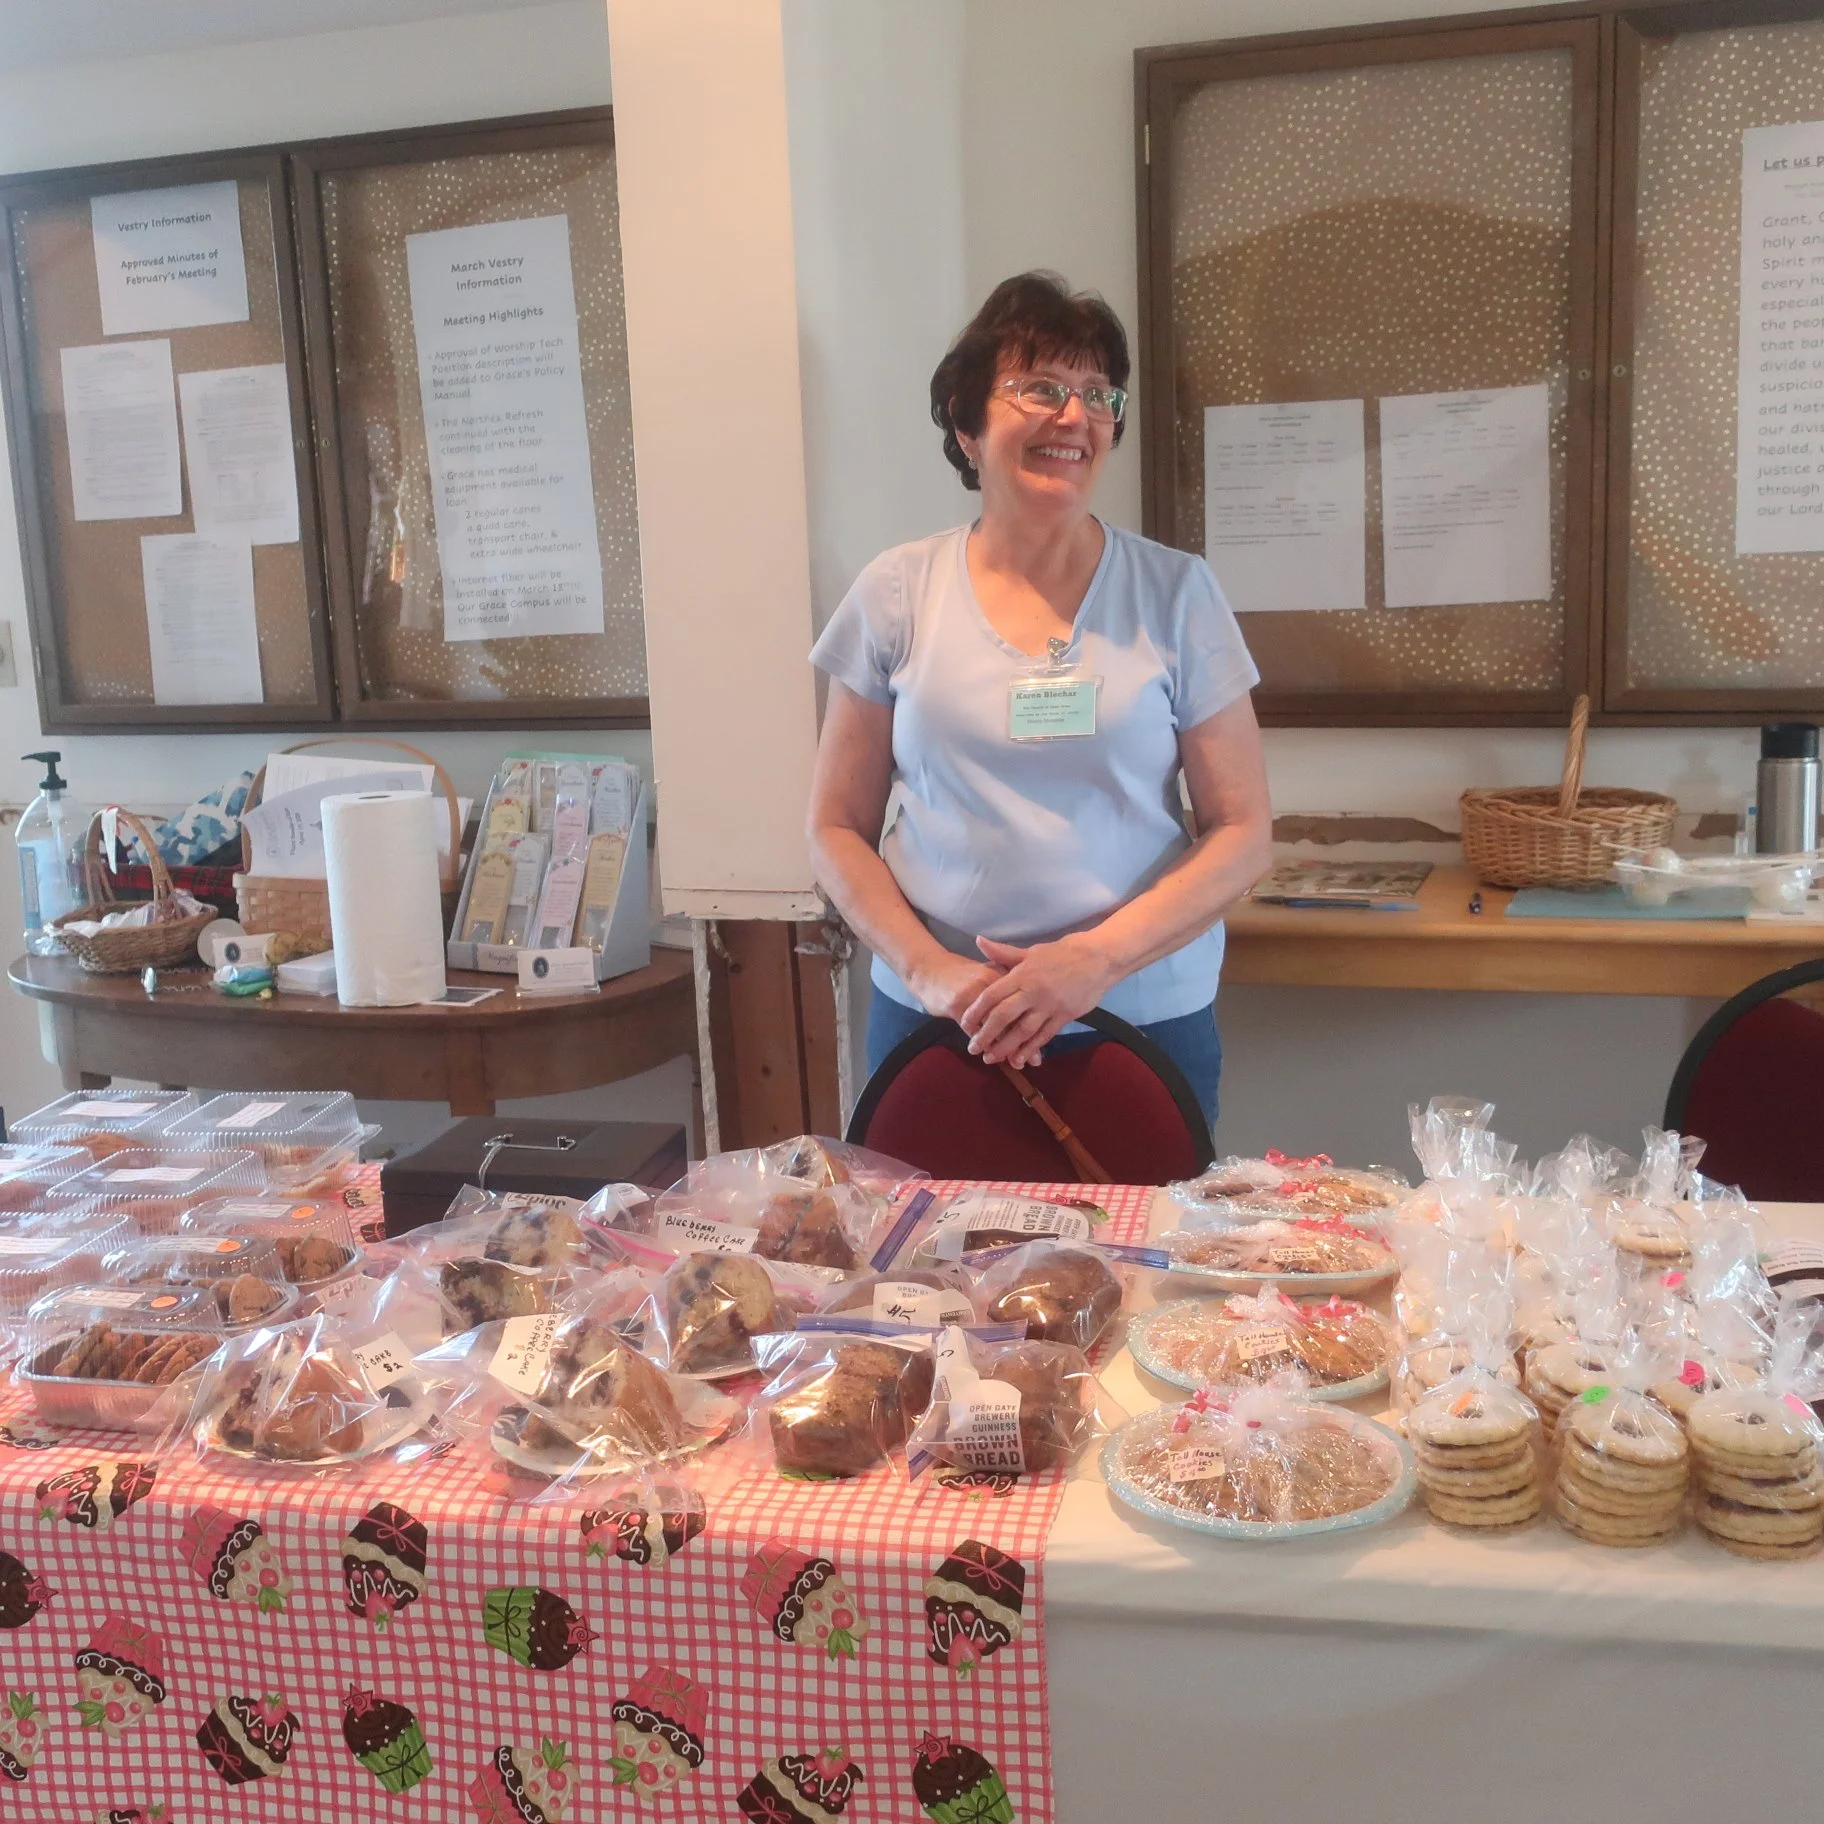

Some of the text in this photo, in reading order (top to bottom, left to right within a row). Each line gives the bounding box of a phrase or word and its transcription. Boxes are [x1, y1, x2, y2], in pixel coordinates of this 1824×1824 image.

[1763, 158, 1788, 171] Let
[1793, 157, 1811, 168] us
[118, 213, 212, 232] Vestry Information
[1762, 234, 1797, 250] holy
[121, 249, 219, 270] Approved Minutes of
[451, 257, 524, 273] March Vestry
[1762, 257, 1807, 271] Spirit
[126, 267, 217, 285] February's Meeting
[456, 274, 523, 291] Information
[1761, 278, 1805, 290] every
[443, 306, 544, 327] Meeting Highlights
[1760, 319, 1787, 332] the
[494, 341, 536, 353] Worship
[540, 337, 563, 348] Tech
[1760, 340, 1795, 352] that
[432, 362, 472, 374] Position
[1760, 358, 1807, 372] divide
[447, 373, 477, 386] added
[480, 374, 491, 383] to
[534, 365, 566, 377] Policy
[434, 388, 471, 400] Manual
[505, 407, 544, 420] Refresh
[1758, 403, 1788, 416] and
[440, 428, 488, 441] continued
[1758, 425, 1785, 436] our
[498, 462, 538, 475] medical
[1756, 463, 1811, 479] justice
[549, 474, 564, 486] for
[1757, 483, 1820, 497] through
[1757, 505, 1785, 517] our
[479, 600, 507, 611] Grace
[510, 598, 551, 609] Campus
[1015, 691, 1042, 700] Karen
[1023, 1204, 1039, 1232] BREAD
[1038, 1204, 1058, 1232] BROWN
[896, 1285, 918, 1295] OPEN
[969, 1404, 1017, 1412] OPEN GATE
[974, 1412, 1016, 1422] BREWERY
[972, 1422, 1018, 1433] GUINNESS
[953, 1433, 1019, 1451] BROWN
[1170, 1451, 1189, 1462] Toll
